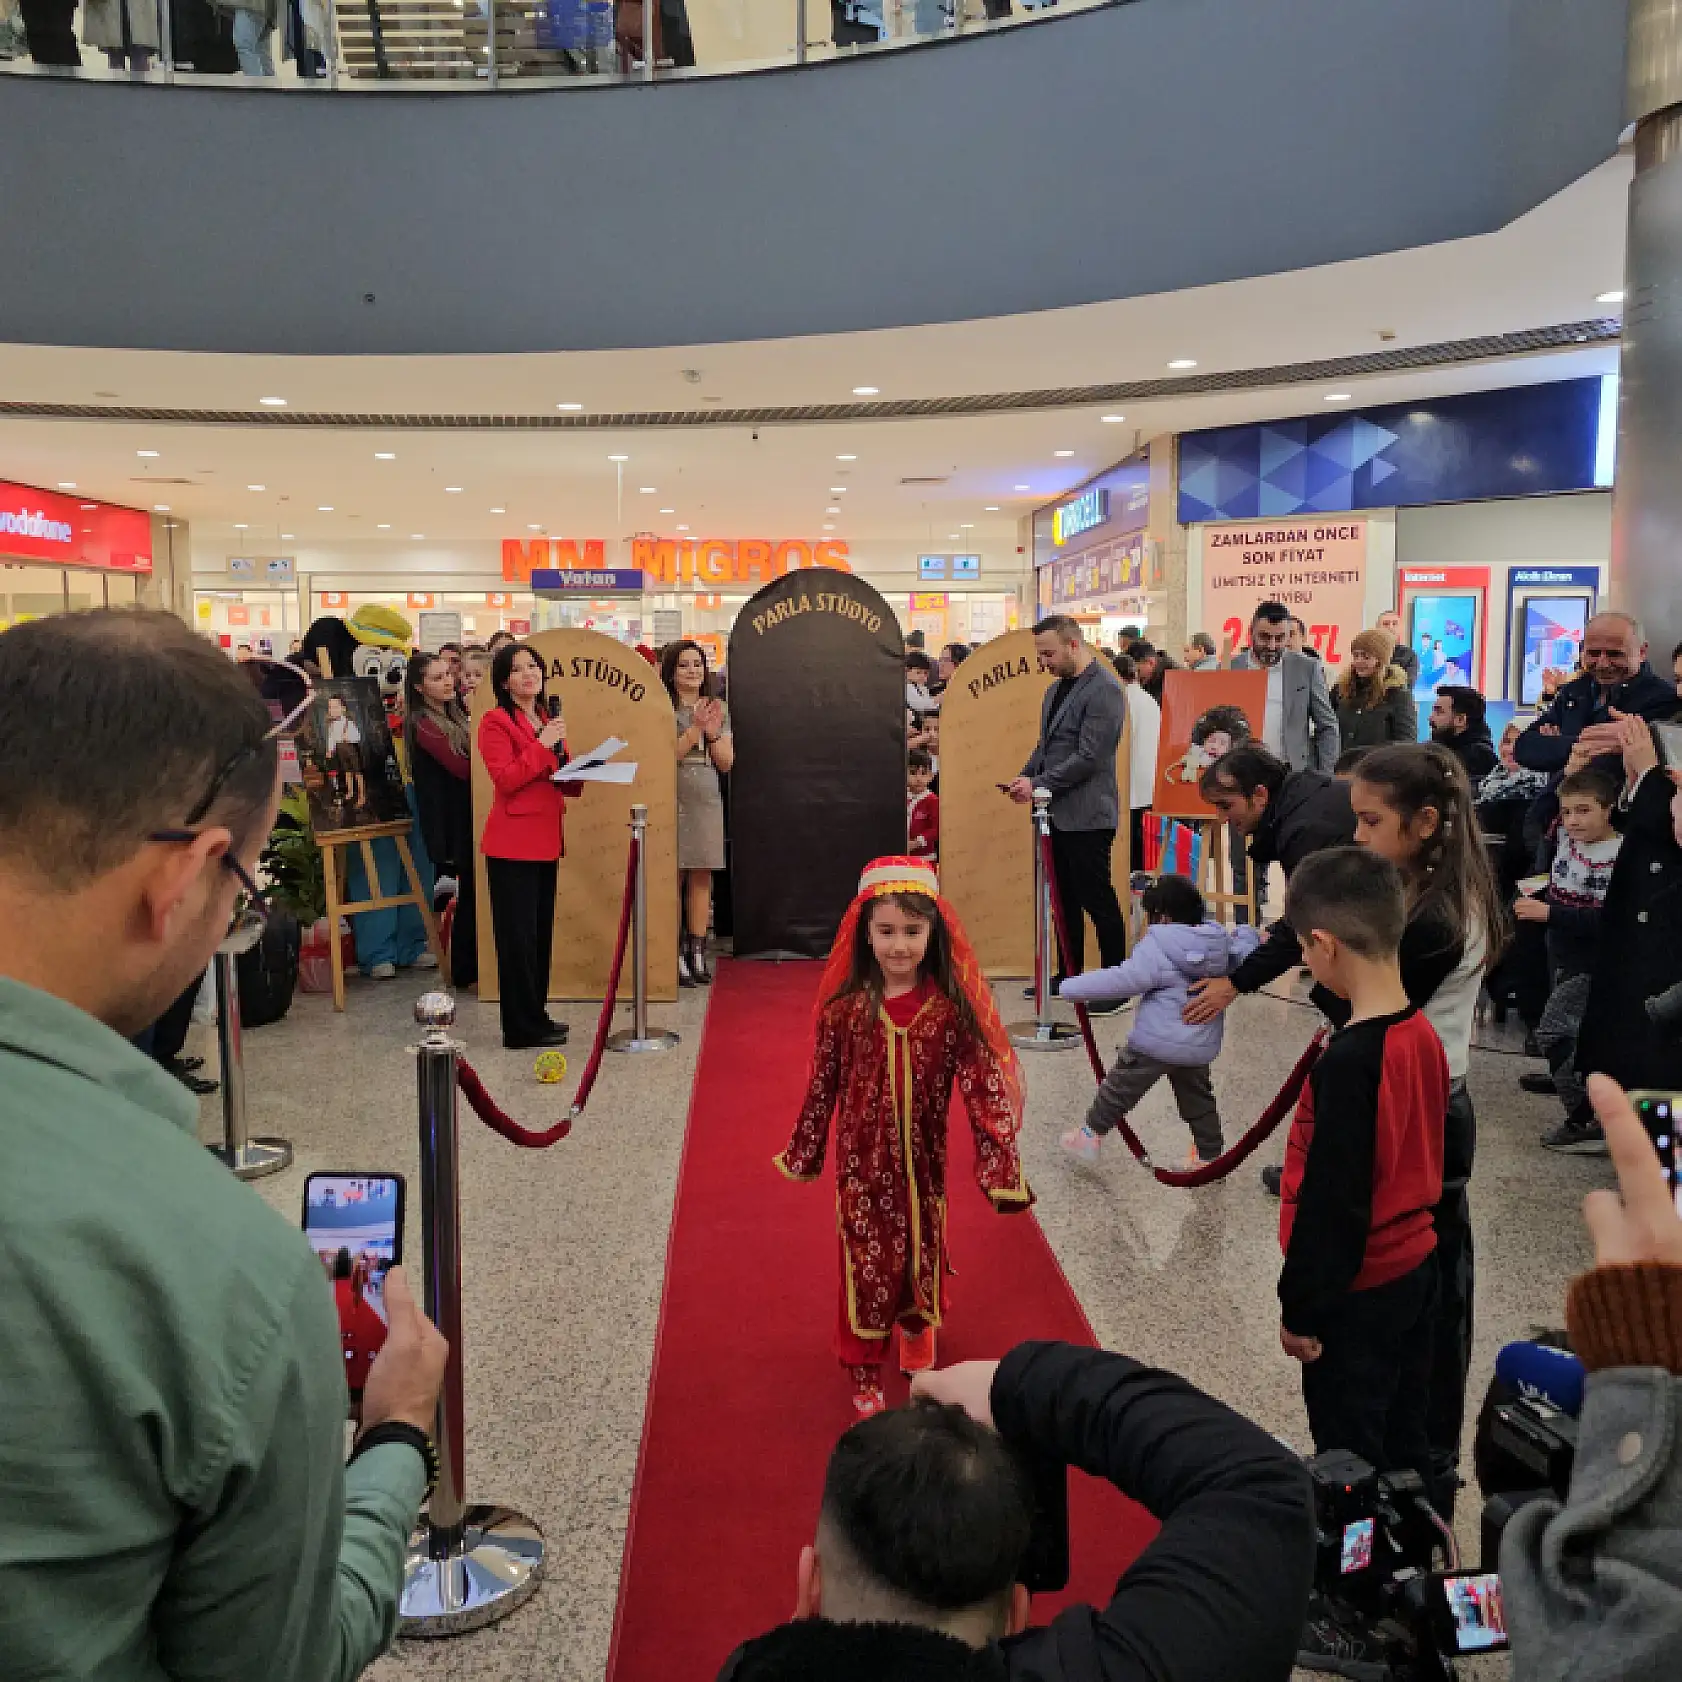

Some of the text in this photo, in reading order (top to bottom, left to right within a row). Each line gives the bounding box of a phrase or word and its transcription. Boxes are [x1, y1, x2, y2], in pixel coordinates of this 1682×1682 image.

[1211, 529, 1308, 548] ZAMLARDAN
[1242, 551, 1275, 565] SON
[559, 570, 617, 585] Vatan
[752, 594, 812, 636] PARLA
[1309, 625, 1342, 663] TL
[967, 656, 1031, 700] PARLA
